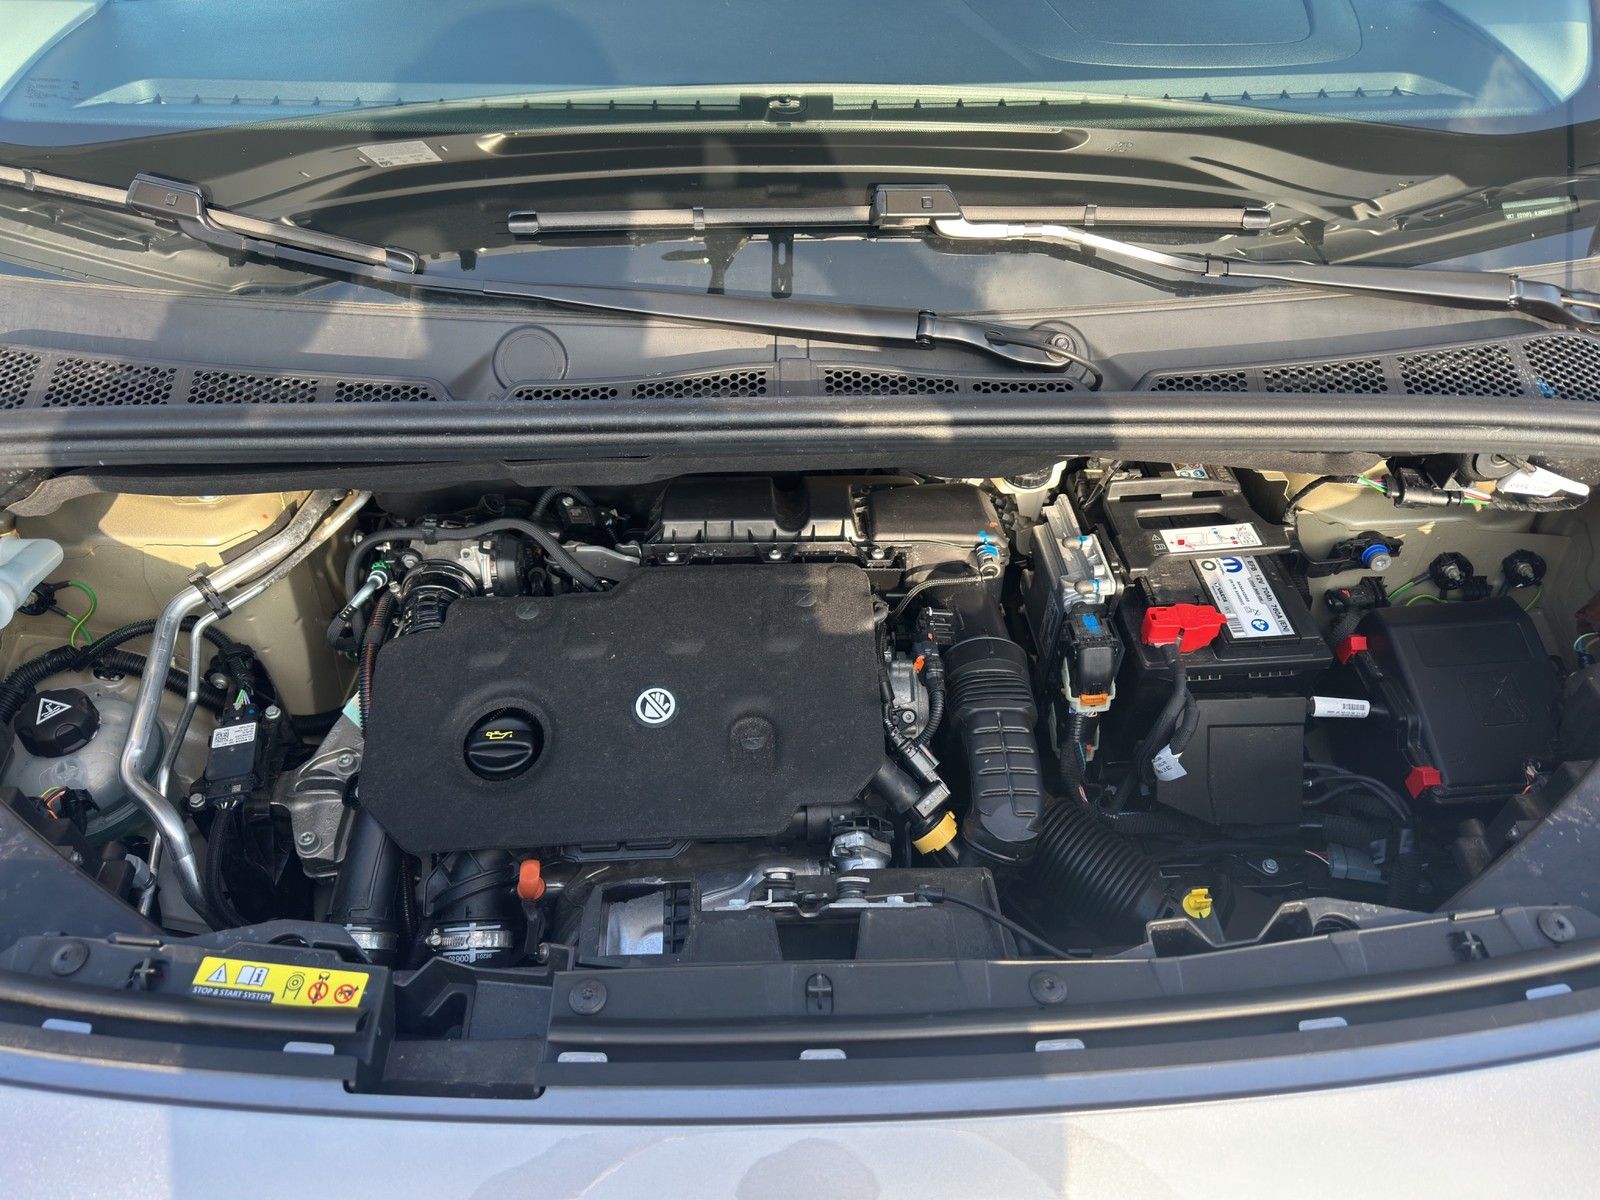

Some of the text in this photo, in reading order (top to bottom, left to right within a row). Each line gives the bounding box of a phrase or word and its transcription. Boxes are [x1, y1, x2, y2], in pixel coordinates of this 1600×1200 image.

[192, 986, 213, 994] STOP
[219, 988, 241, 998] START
[242, 991, 272, 1001] SYSTEM
